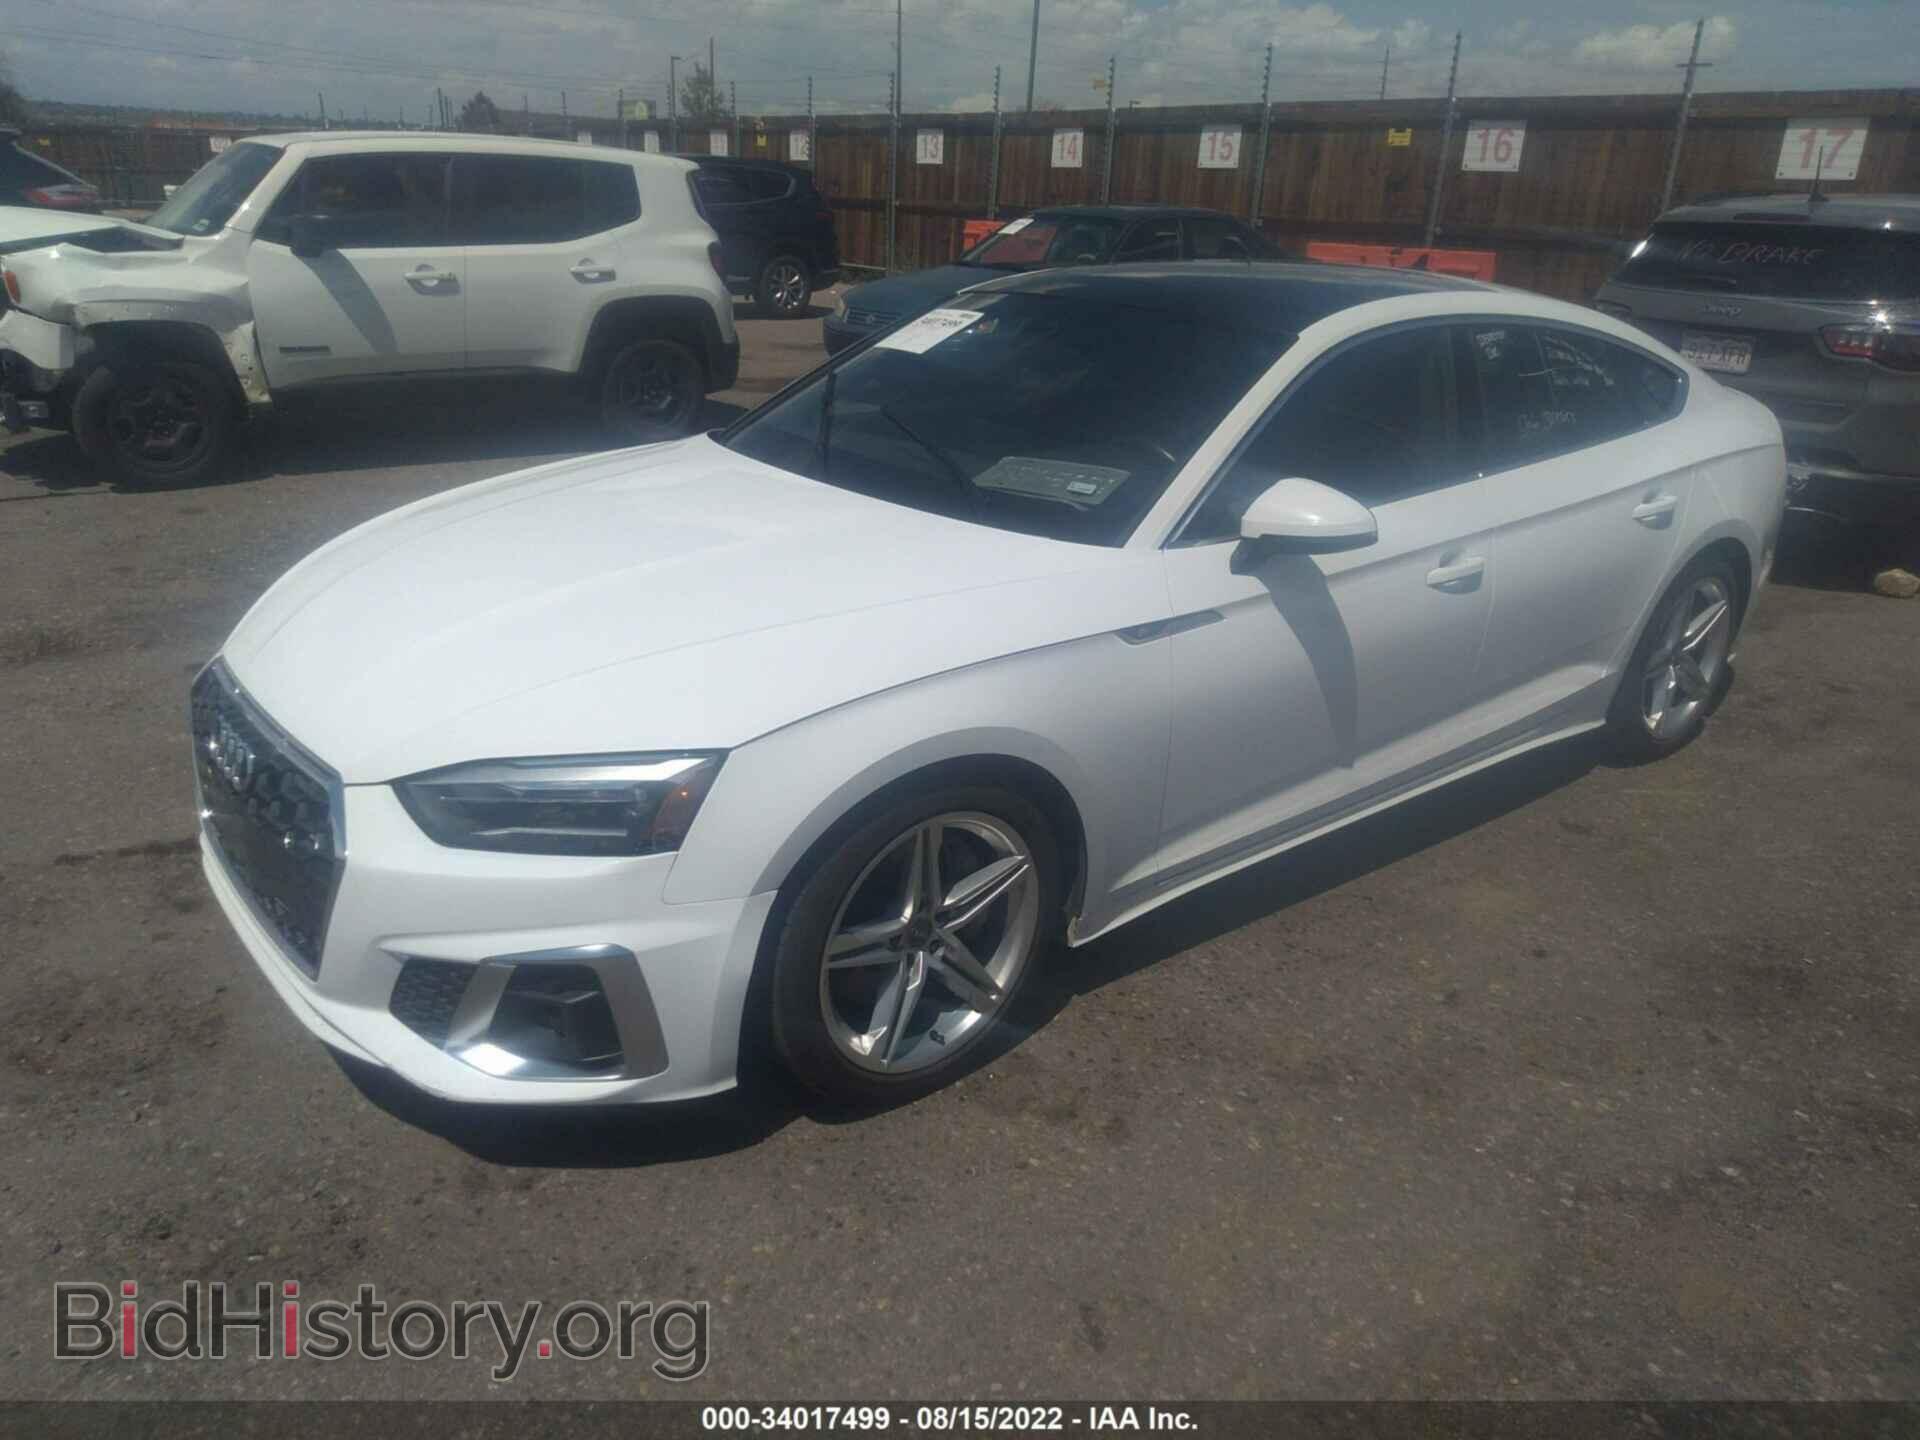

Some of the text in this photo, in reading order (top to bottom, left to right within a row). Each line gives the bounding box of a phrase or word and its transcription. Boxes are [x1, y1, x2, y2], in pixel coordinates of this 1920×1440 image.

[921, 135, 939, 160] 13
[1056, 134, 1079, 161] 14
[1207, 133, 1233, 161] 15
[1478, 128, 1514, 162] 16
[1799, 127, 1855, 169] 17
